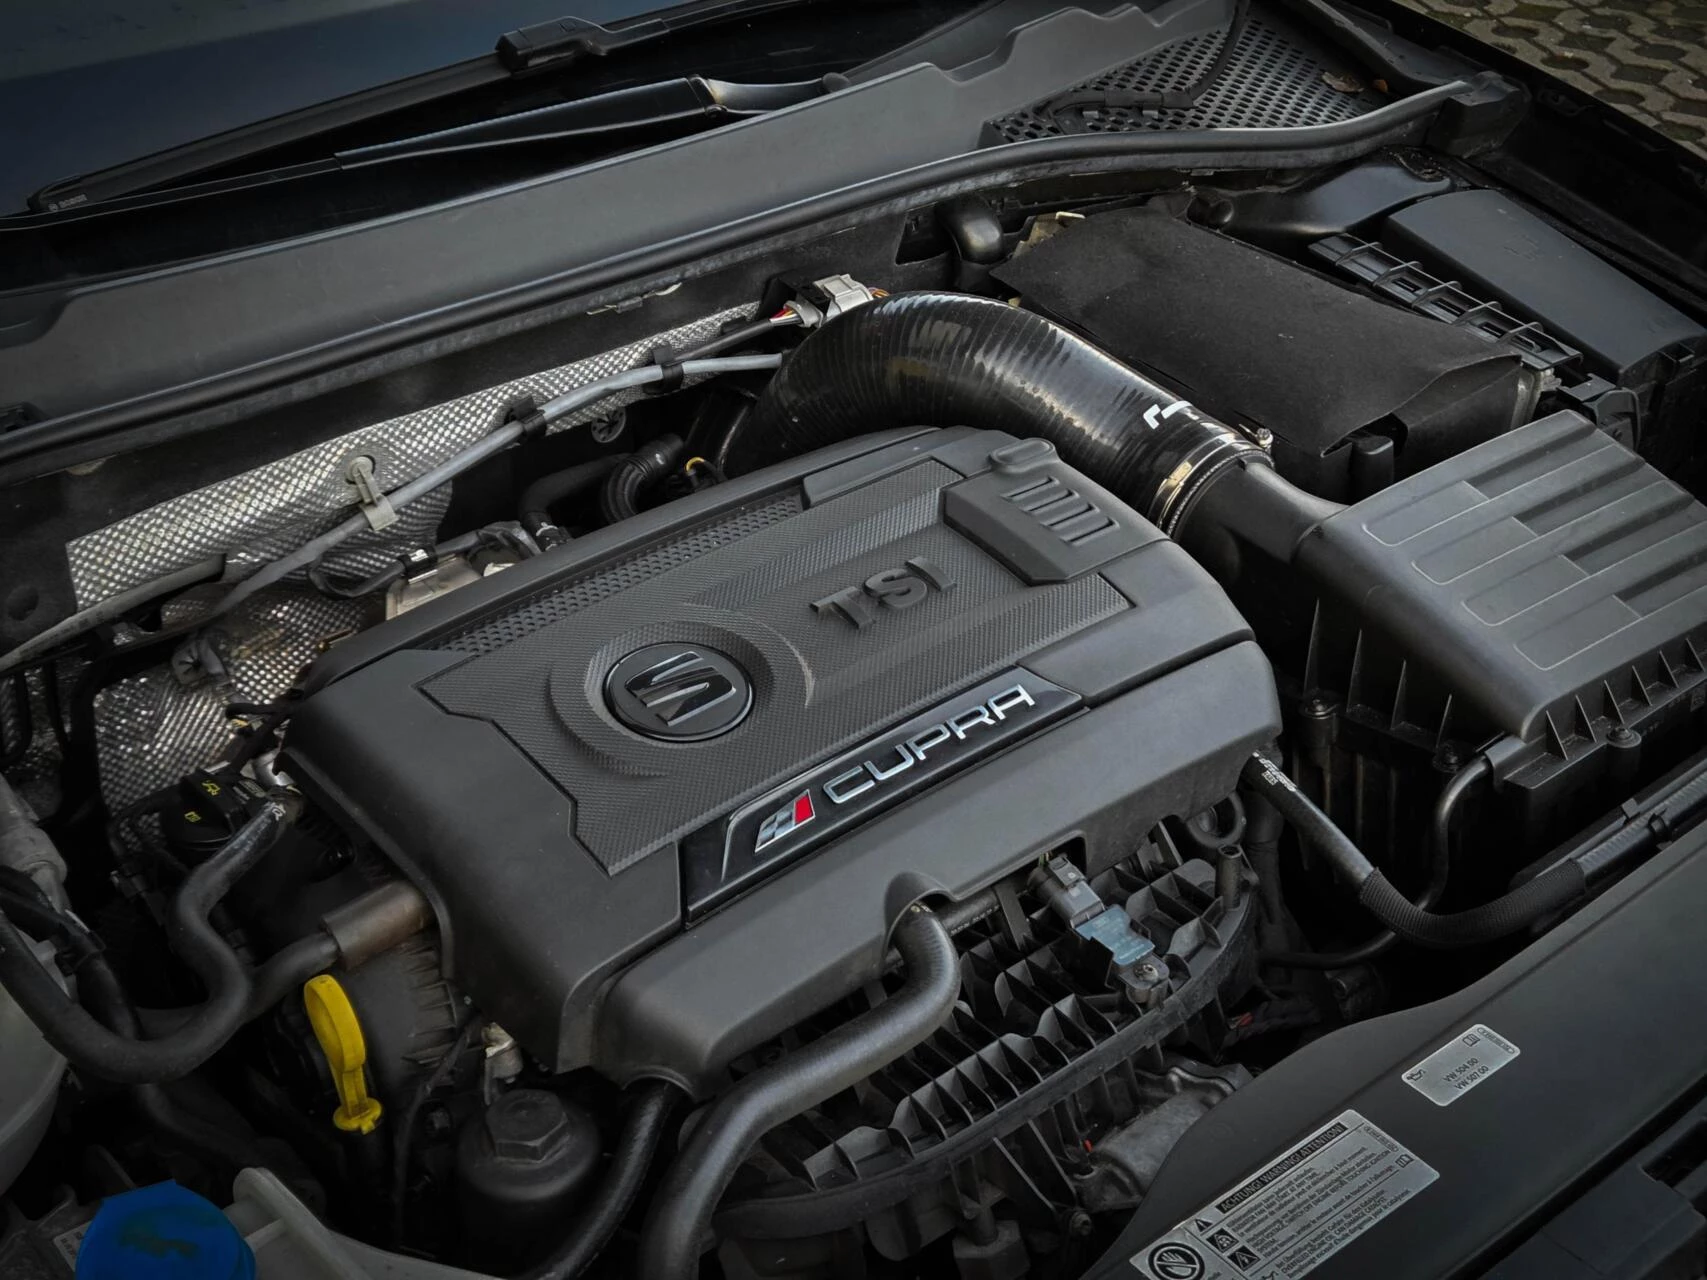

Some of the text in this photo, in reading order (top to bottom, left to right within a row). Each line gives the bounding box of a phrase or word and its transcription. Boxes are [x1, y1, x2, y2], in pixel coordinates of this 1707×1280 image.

[809, 556, 957, 629] TSI
[823, 684, 1035, 804] CUPRA
[1443, 1073, 1458, 1083] VW
[1455, 1062, 1471, 1075] 504
[1454, 1080, 1469, 1090] VW
[1219, 1179, 1264, 1211] ACHTUNG!
[1258, 1152, 1303, 1184] WARNING!
[1296, 1123, 1344, 1157] ATTENTION!
